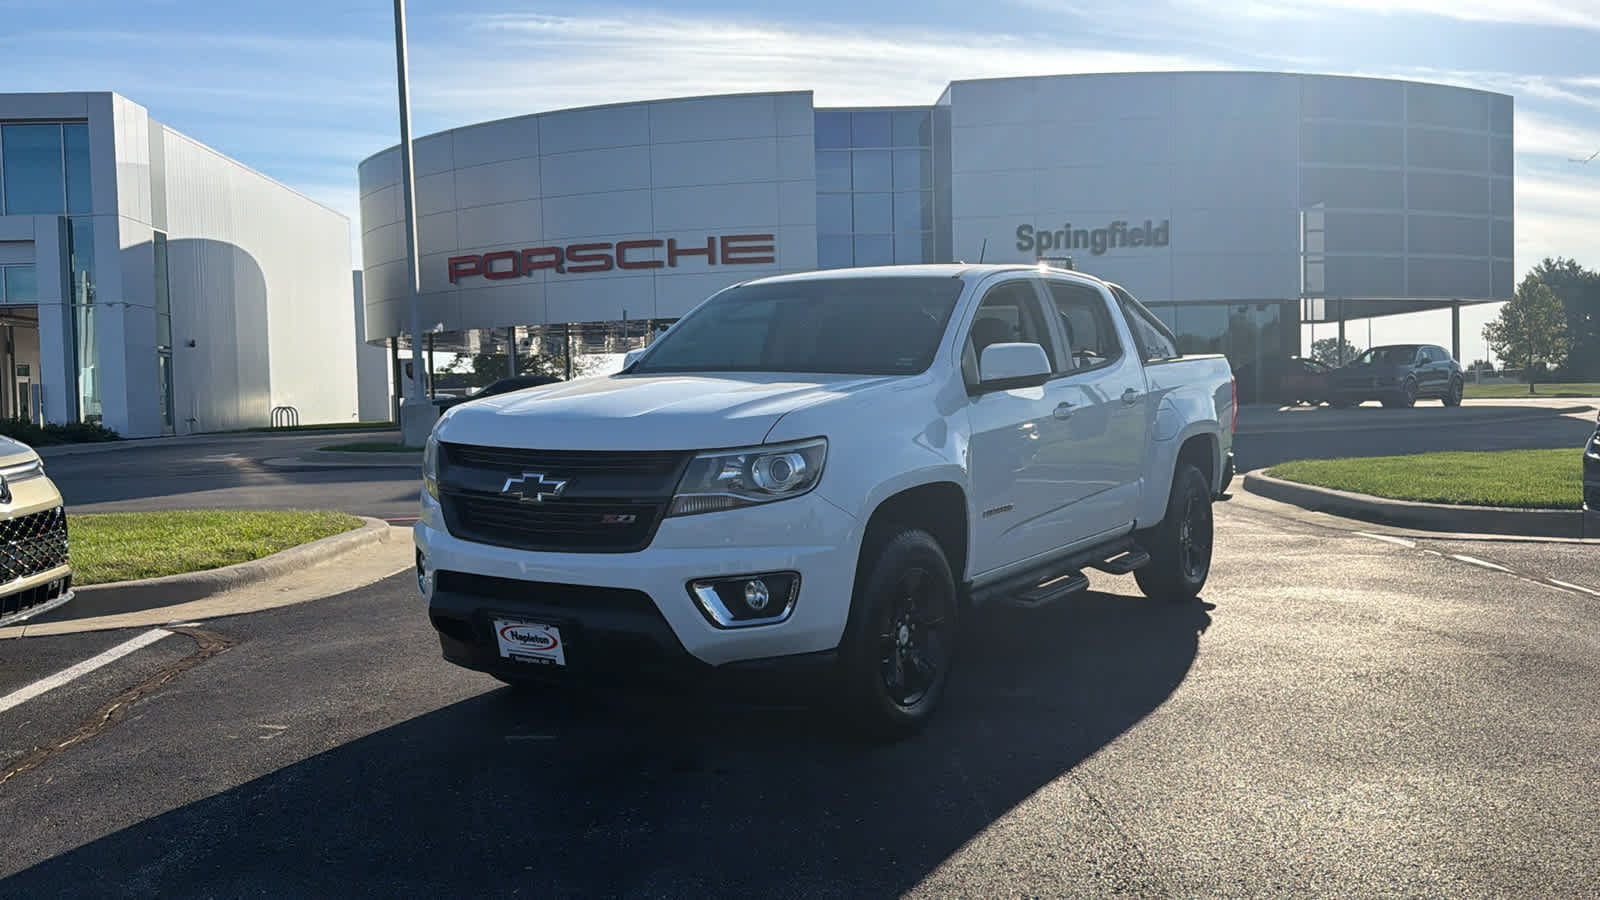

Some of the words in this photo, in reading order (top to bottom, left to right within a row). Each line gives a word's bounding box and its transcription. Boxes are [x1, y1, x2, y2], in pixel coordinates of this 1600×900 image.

[1016, 219, 1170, 256] Springfield
[448, 234, 775, 284] PORSCHE
[510, 630, 550, 644] Napleton
